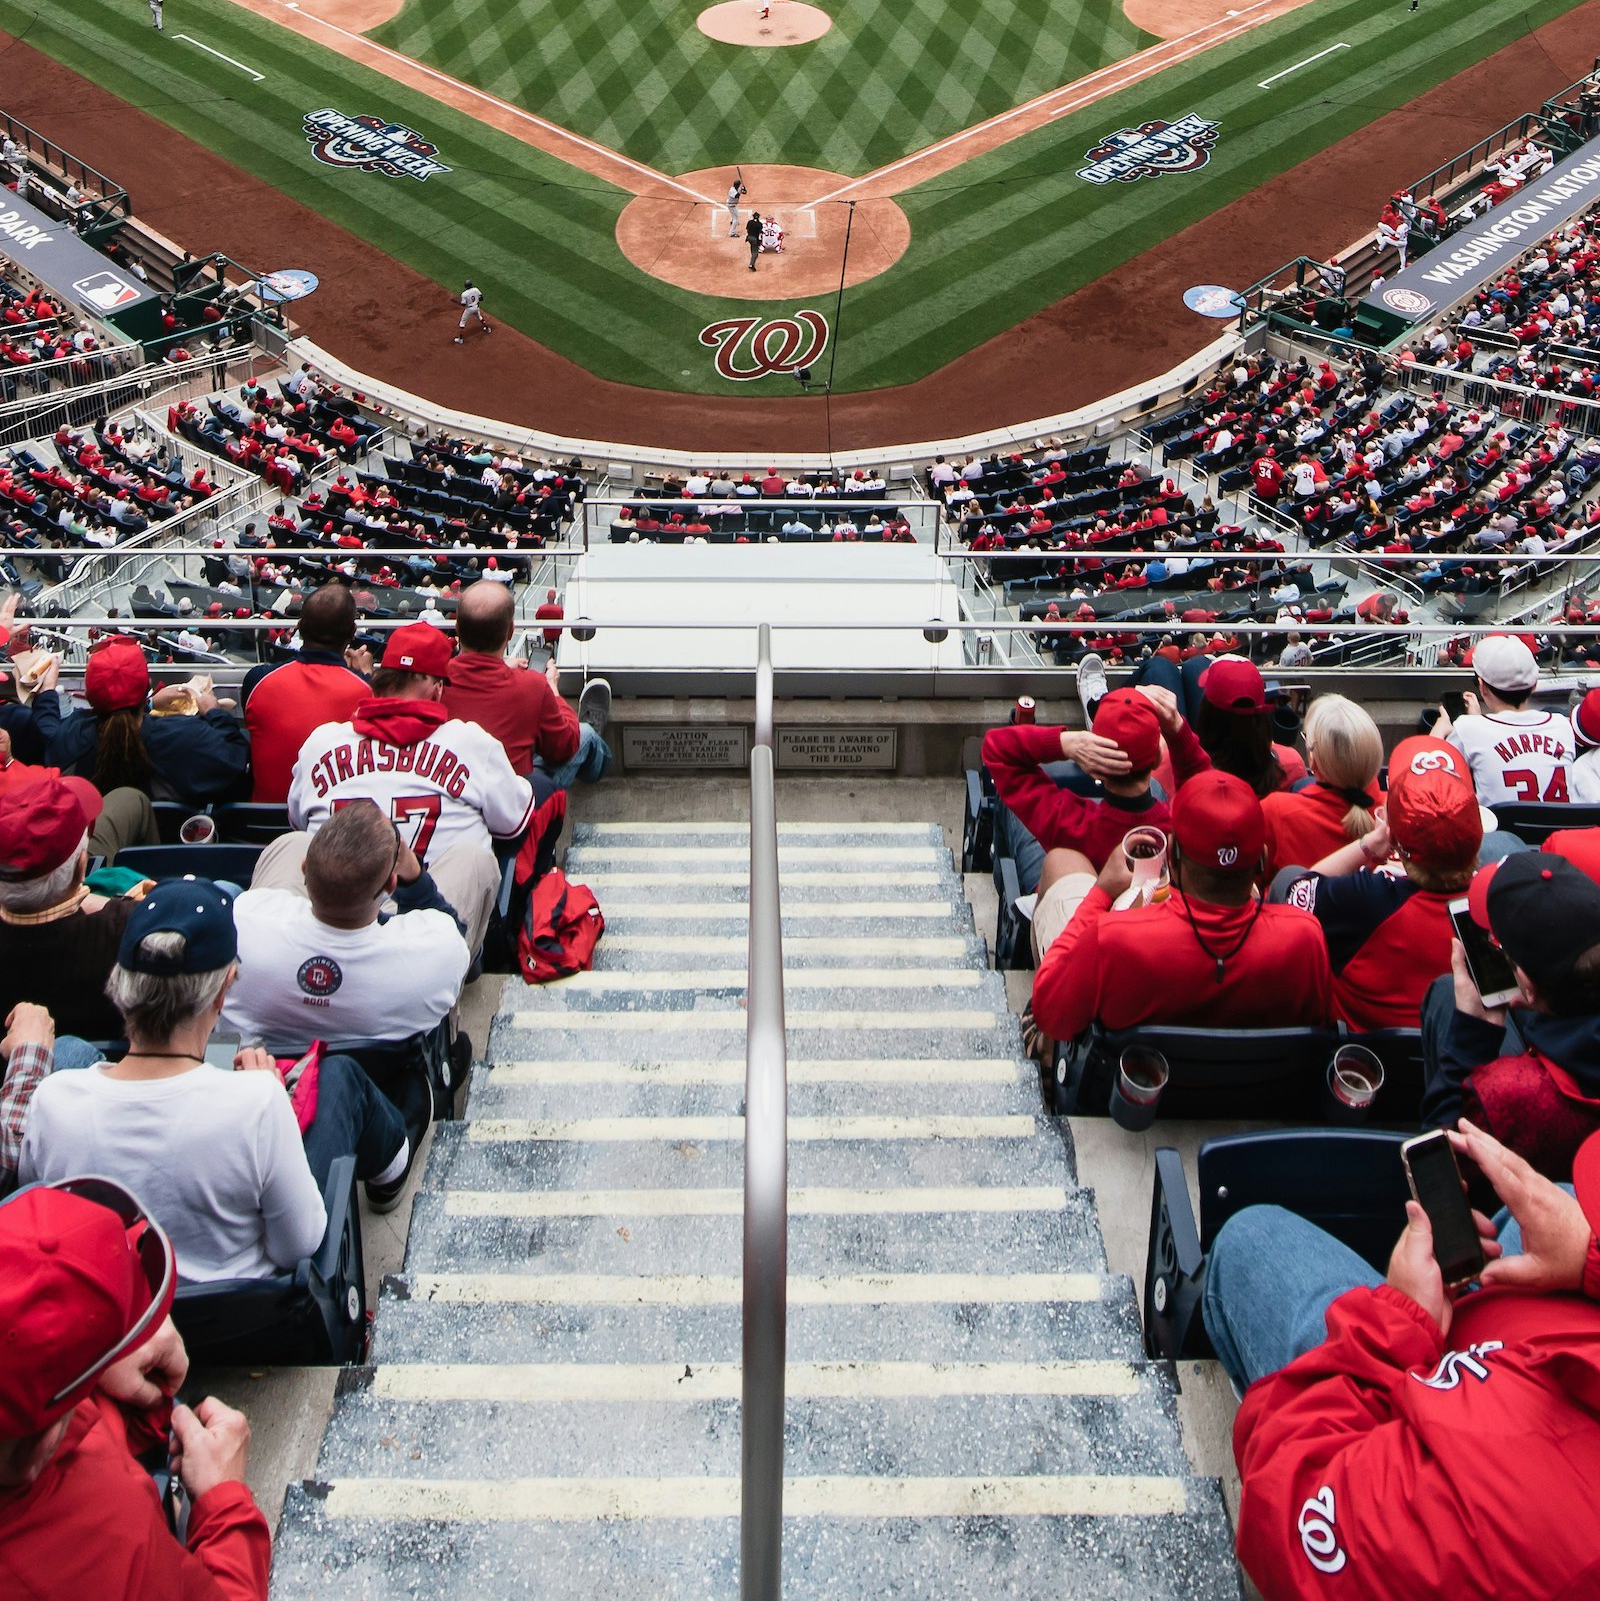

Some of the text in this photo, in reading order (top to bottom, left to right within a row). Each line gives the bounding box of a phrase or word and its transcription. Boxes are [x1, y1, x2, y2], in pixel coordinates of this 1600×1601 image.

[308, 109, 447, 177] OPENING WEEK
[1079, 116, 1217, 183] OPENING WEEK
[1422, 202, 1548, 285] WASHINGTON
[700, 310, 829, 381] W
[782, 735, 890, 744] PLEASE BE AWARE OF
[791, 745, 880, 753] OBJECTS LEAVING
[810, 754, 863, 763] THE FIELD
[1493, 734, 1565, 763] HARPER
[311, 739, 470, 798] STRASBURG
[1502, 767, 1570, 803] 34
